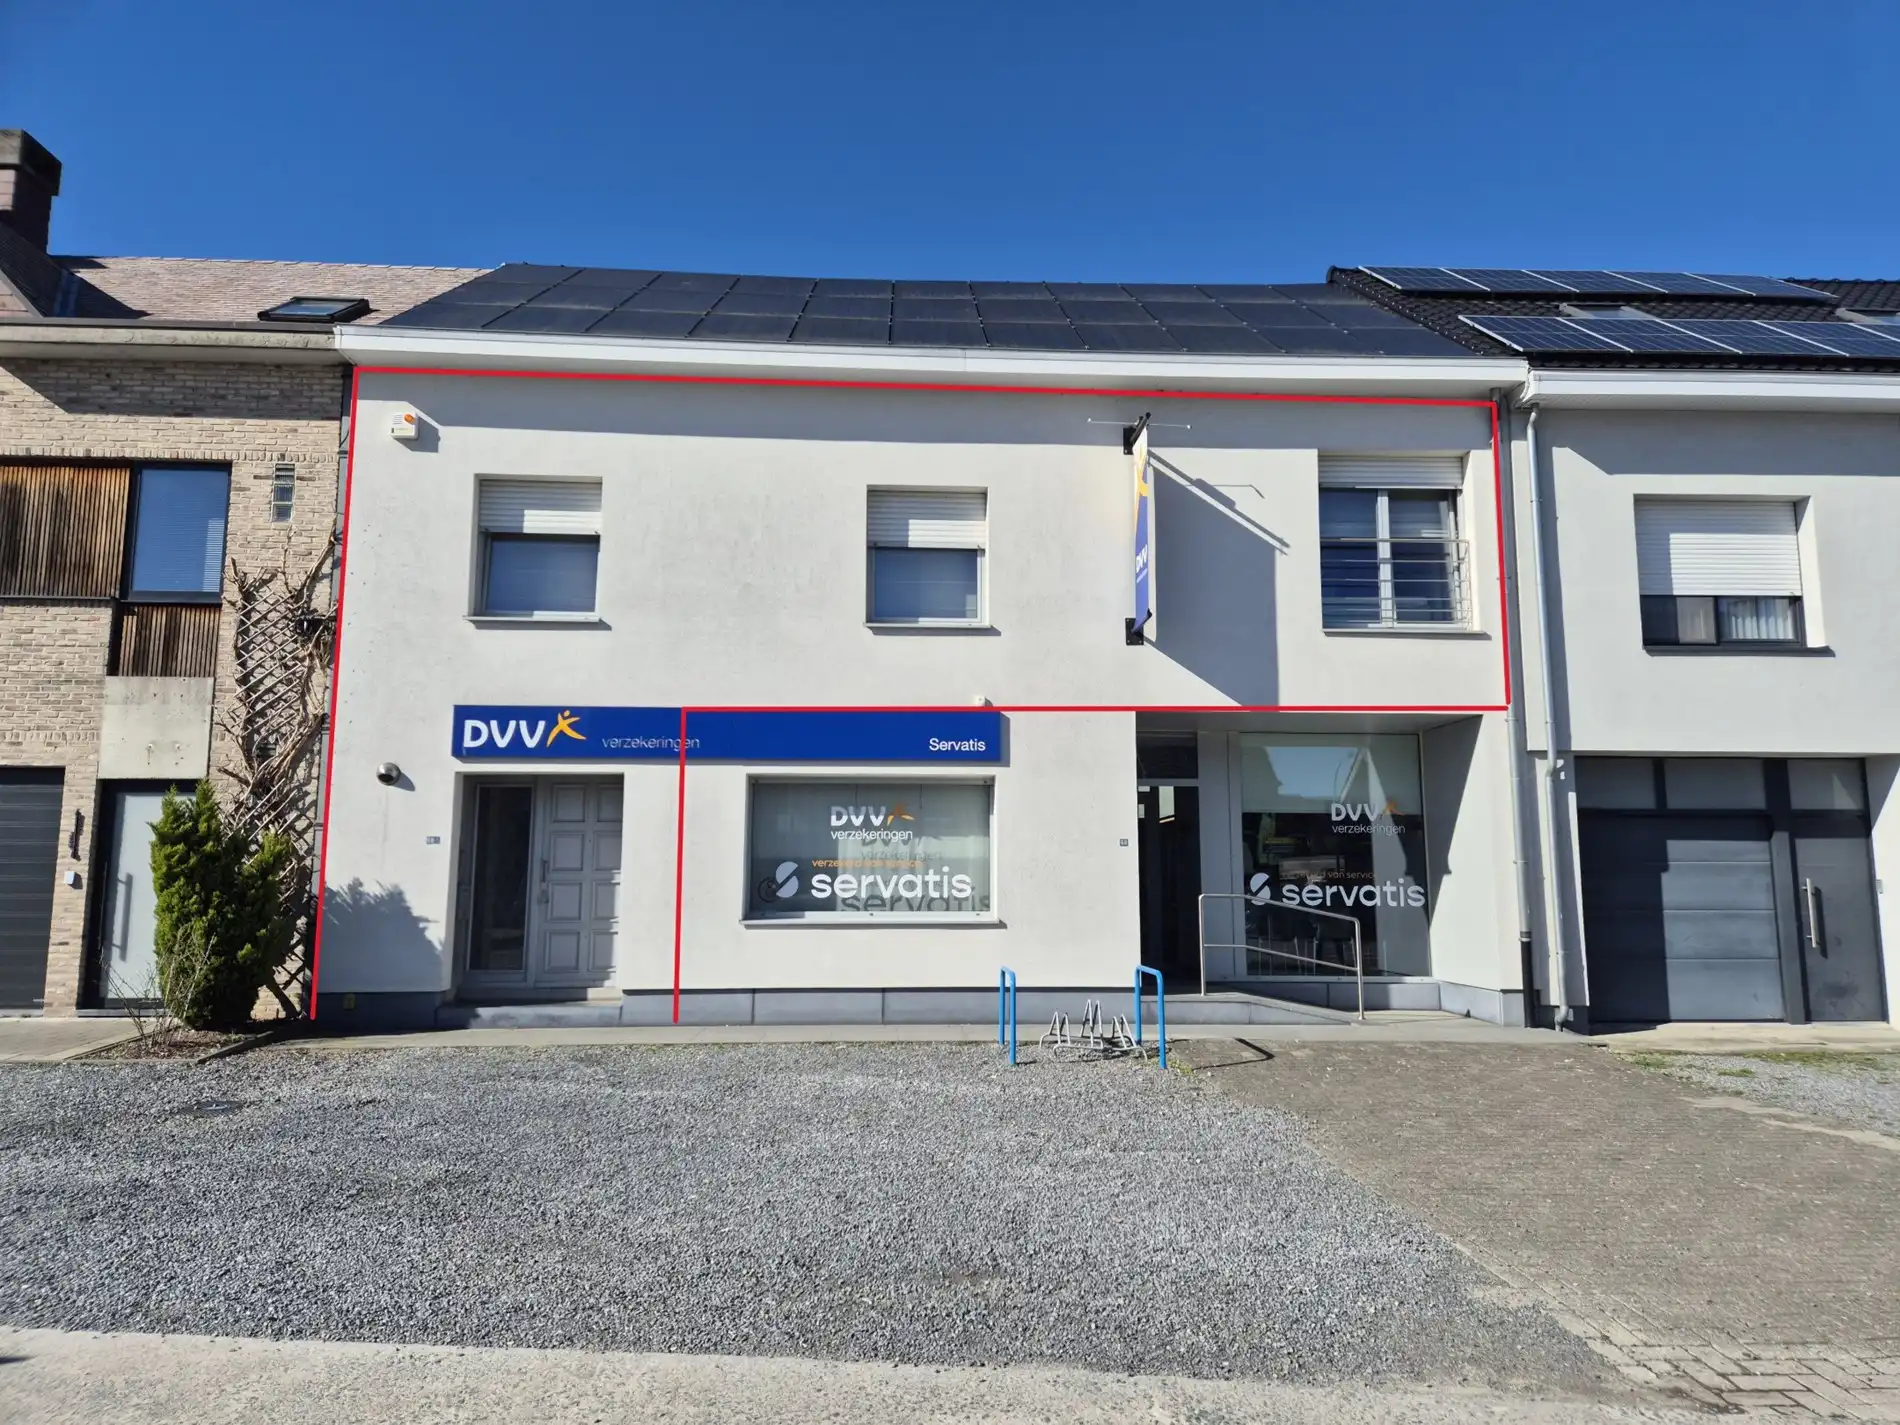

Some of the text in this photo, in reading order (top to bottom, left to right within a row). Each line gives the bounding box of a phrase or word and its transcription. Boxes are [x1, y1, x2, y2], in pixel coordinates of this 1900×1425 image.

[463, 720, 700, 752] DVV verzekeringen
[929, 738, 986, 751] Servatis
[831, 806, 886, 827] DVV
[1331, 803, 1378, 821] DVV
[831, 829, 913, 842] verzekeringen
[1332, 824, 1406, 836] verzekeringen
[811, 866, 972, 898] servatis
[1282, 878, 1426, 907] servatis
